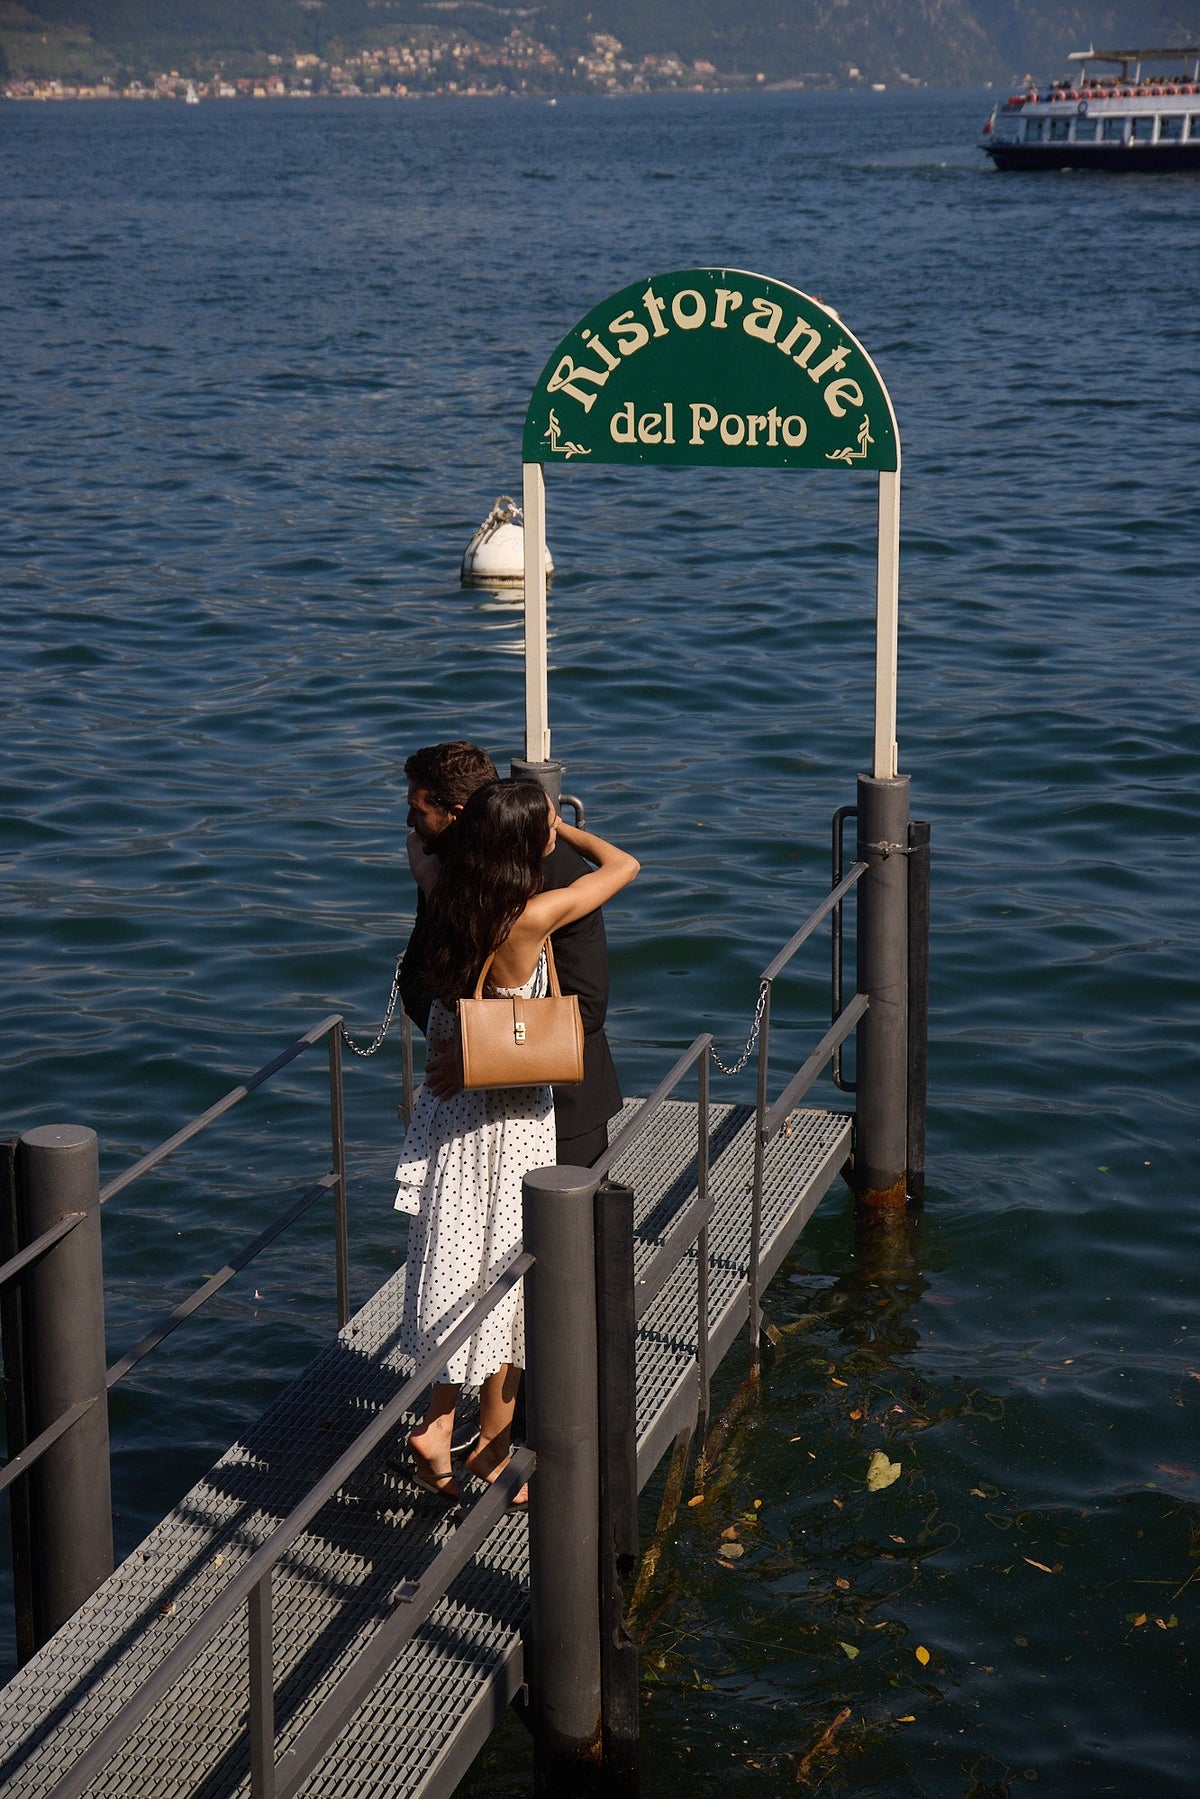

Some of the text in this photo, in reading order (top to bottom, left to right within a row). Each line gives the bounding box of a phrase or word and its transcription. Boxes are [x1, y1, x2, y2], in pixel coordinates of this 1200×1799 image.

[546, 286, 864, 418] Ristorante
[609, 401, 808, 447] del Porto
